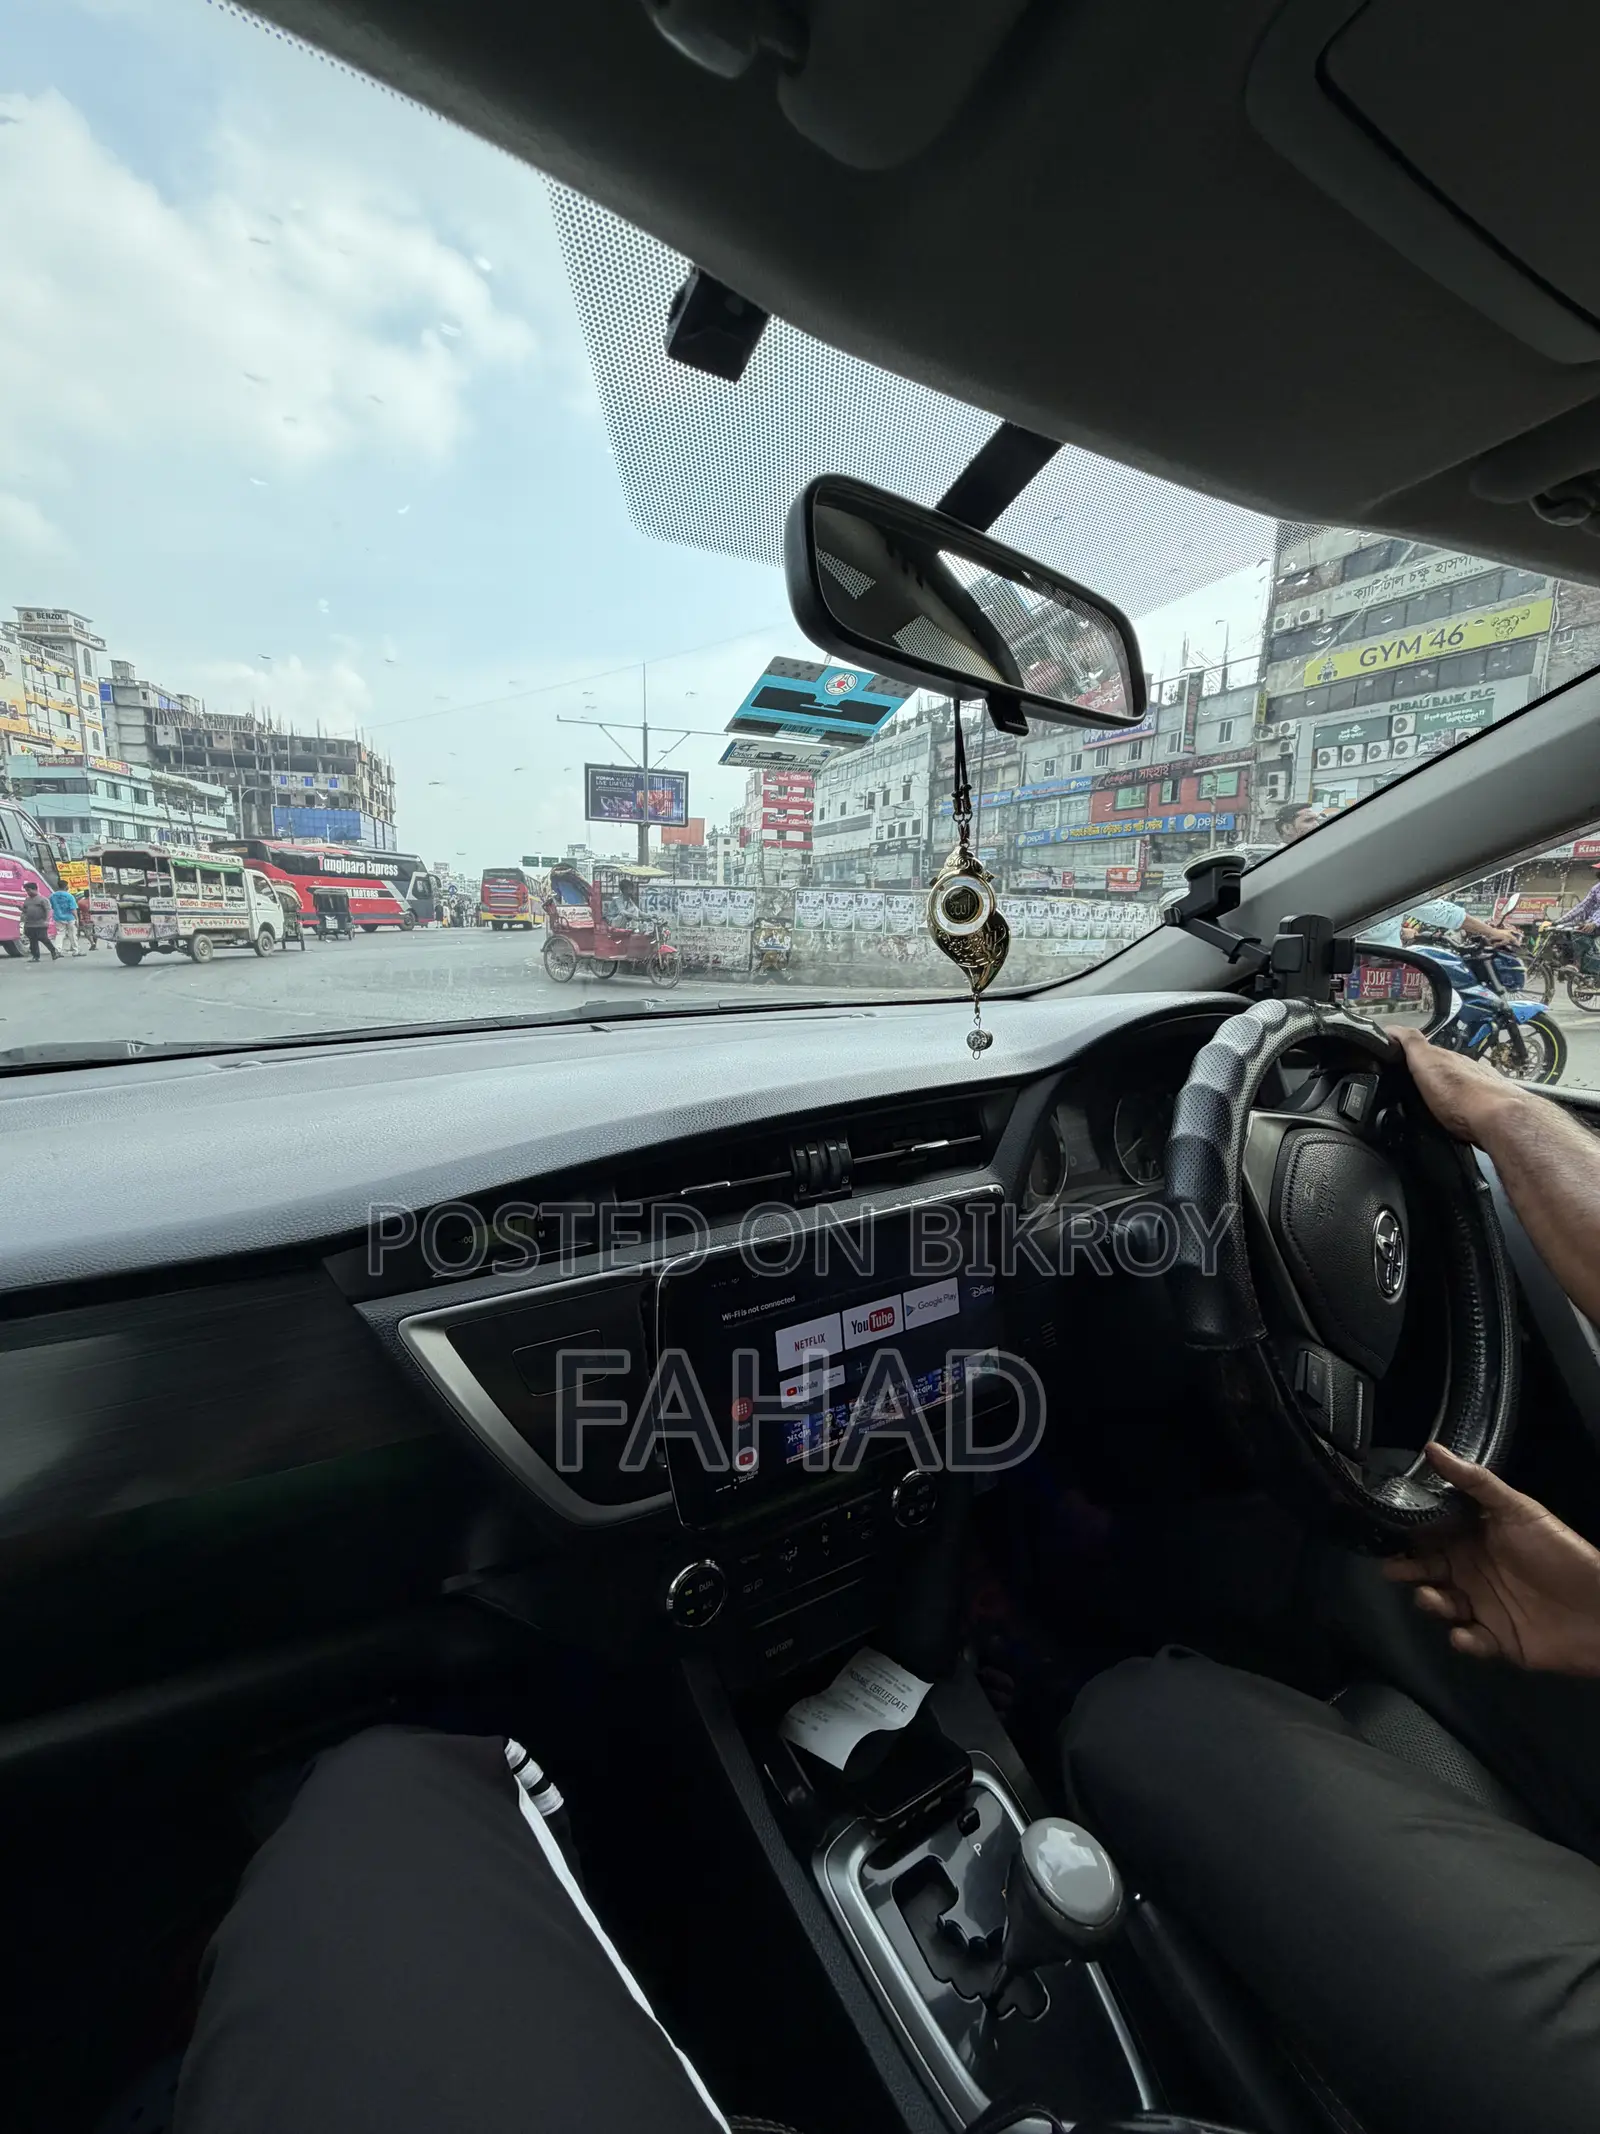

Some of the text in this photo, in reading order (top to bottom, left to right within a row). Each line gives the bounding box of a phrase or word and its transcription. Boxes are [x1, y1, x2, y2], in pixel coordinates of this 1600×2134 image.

[1408, 565, 1431, 584] চক্ষু
[36, 612, 64, 620] BENZOL
[1359, 635, 1422, 667] GYM
[1429, 625, 1465, 649] 46
[1390, 699, 1430, 713] PUBALI
[1432, 692, 1467, 706] BANK
[1197, 814, 1227, 829] pesi
[1026, 833, 1046, 845] pepsi
[366, 861, 398, 876] Express
[353, 888, 379, 899] MOTORS
[748, 1303, 759, 1314] not
[761, 1295, 796, 1309] connected
[918, 1293, 957, 1310] Google Play
[851, 1313, 894, 1334] YouTube
[794, 1333, 826, 1351] NETFLIX
[699, 1580, 715, 1592] DUAL
[869, 1682, 909, 1713] CERTIFICATE
[974, 1844, 983, 1857] P
